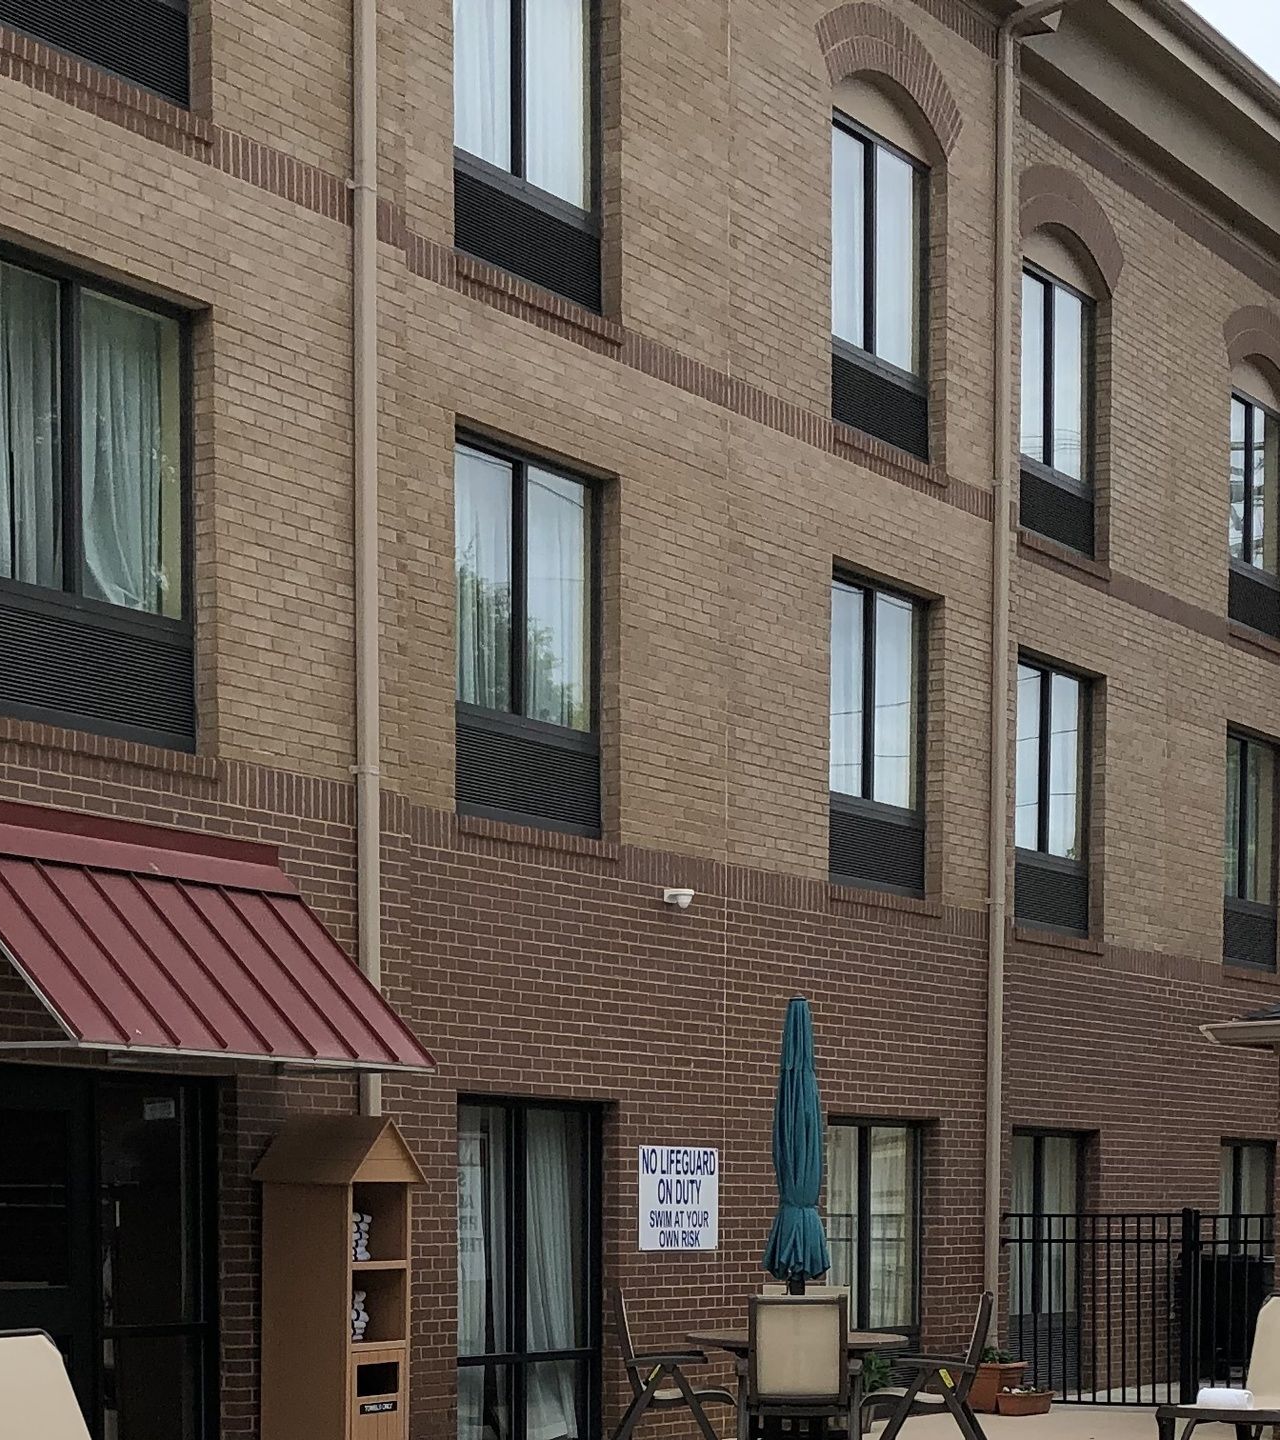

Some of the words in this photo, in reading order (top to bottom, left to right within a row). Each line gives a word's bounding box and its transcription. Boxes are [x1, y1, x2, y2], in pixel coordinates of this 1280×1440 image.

[642, 1148, 657, 1174] NO
[660, 1149, 716, 1175] LIFEGUARD
[658, 1178, 672, 1204] ON
[675, 1179, 702, 1204] DUTY
[649, 1210, 672, 1228] SWIM
[674, 1211, 684, 1228] AT
[686, 1211, 709, 1228] YOUR
[659, 1230, 679, 1247] OWN
[681, 1230, 700, 1247] RISK
